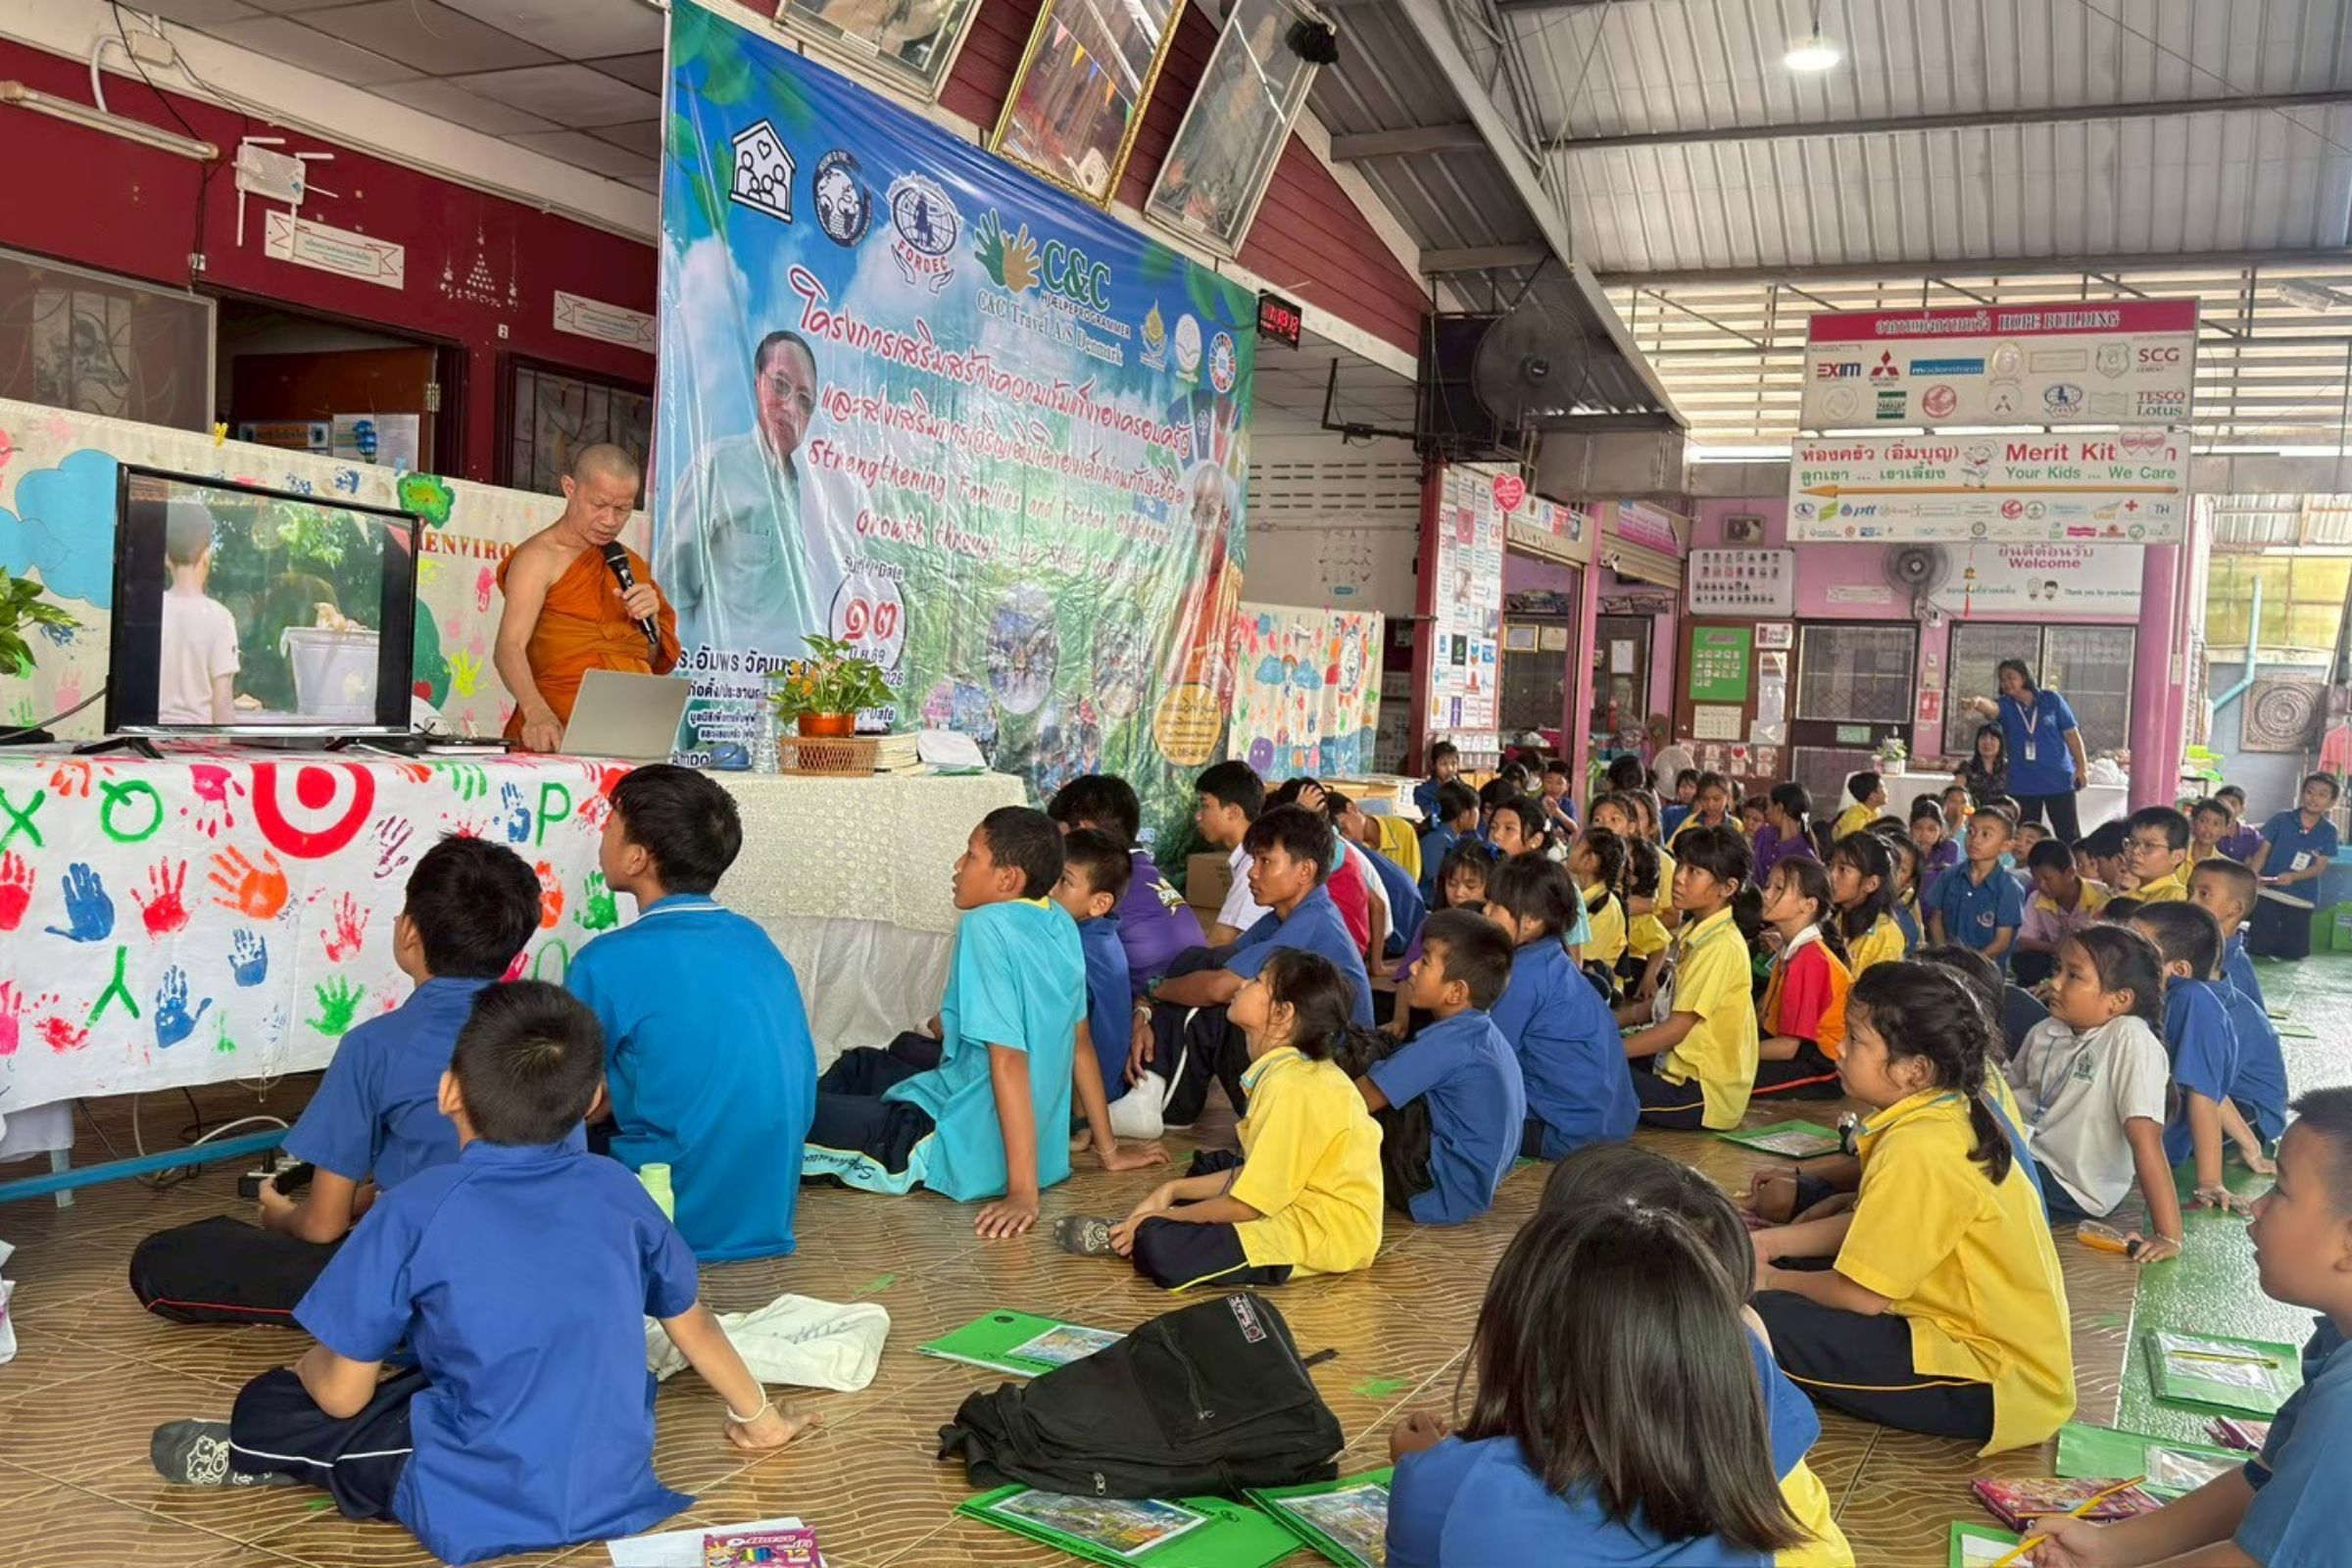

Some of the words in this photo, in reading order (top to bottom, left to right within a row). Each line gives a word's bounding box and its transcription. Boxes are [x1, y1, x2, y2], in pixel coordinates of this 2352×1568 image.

[898, 241, 948, 272] FORDEC
[1042, 240, 1110, 312] C&C
[978, 291, 1006, 319] C&C
[1011, 304, 1049, 335] Travel
[1076, 329, 1123, 366] Denmark
[1997, 313, 2040, 331] HOPE
[2043, 310, 2120, 330] BUILDING
[2138, 347, 2180, 364] SCG
[2136, 391, 2185, 401] TESCO
[2136, 403, 2182, 416] Lotus
[1801, 443, 1875, 463] ห้องครัว
[2006, 443, 2069, 462] Merit
[808, 438, 947, 502] Strengthening
[957, 474, 1020, 513] Families
[1028, 495, 1056, 518] and
[2006, 466, 2040, 479] Your
[2047, 466, 2081, 479] Kids
[2108, 466, 2132, 479] We
[2139, 466, 2177, 479] Care
[856, 509, 925, 544] Growth
[424, 531, 516, 561] ENVIRO
[2009, 557, 2082, 569] Welcome
[675, 645, 740, 672] ร.อัมพร
